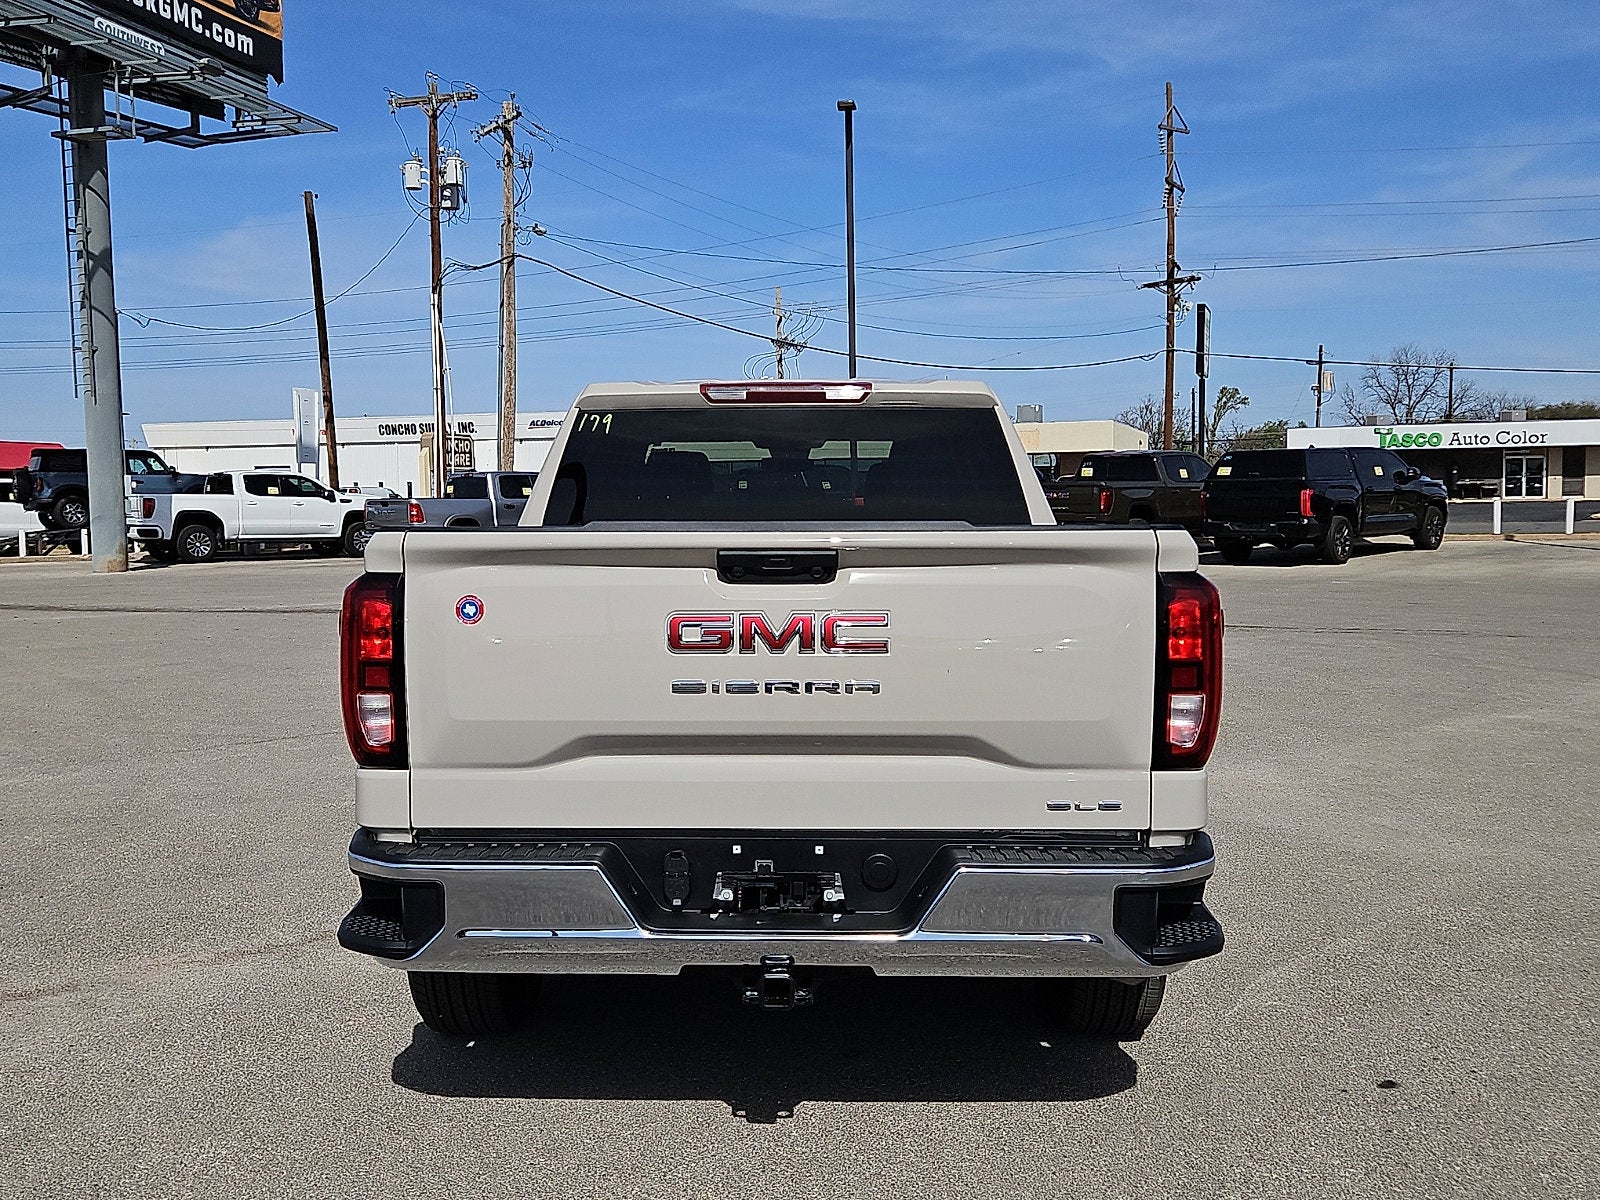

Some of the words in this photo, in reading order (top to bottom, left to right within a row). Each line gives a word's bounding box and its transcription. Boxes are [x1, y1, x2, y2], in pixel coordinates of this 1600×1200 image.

[96, 20, 164, 55] SOUTHWEST
[378, 423, 417, 436] CONCHO
[457, 421, 478, 434] INC.
[577, 413, 613, 434] 179
[1373, 427, 1443, 449] TASCO
[1448, 432, 1491, 447] Auto
[1495, 429, 1549, 446] Color
[665, 609, 892, 657] GMC
[670, 678, 882, 696] SIERRA
[1045, 799, 1123, 813] SLE
